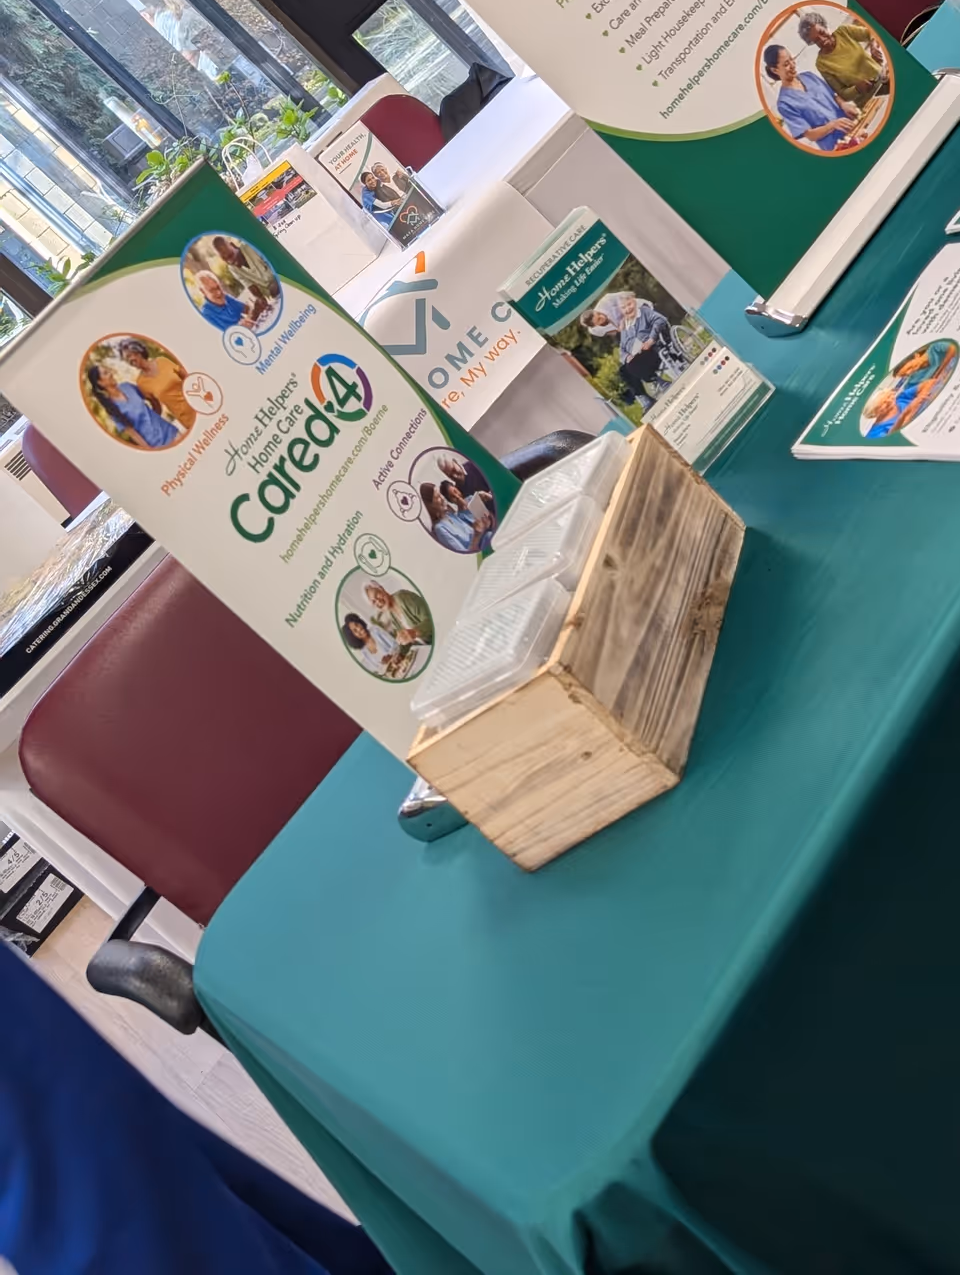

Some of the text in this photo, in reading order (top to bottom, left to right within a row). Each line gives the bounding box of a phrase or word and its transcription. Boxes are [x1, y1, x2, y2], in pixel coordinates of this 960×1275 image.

[609, 9, 631, 30] Care
[624, 22, 649, 48] Meal
[658, 21, 713, 80] Transportation
[711, 3, 728, 23] and
[642, 42, 665, 65] Light
[328, 132, 367, 166] YOUR HEALTH,
[334, 149, 358, 171] AT HOME
[525, 224, 586, 287] RECUPERATIVE CARE
[535, 271, 572, 312] Home
[553, 285, 578, 309] Making
[573, 272, 587, 287] Life
[255, 303, 316, 375] Mental Wellbeing
[427, 326, 489, 389] OME
[460, 362, 488, 387] My
[484, 329, 521, 362] way.
[161, 413, 229, 497] Physical Wellness
[225, 427, 263, 476] Home
[247, 404, 304, 474] Home Care
[372, 407, 428, 491] Active Connections
[280, 403, 389, 564] homehelpershomecare.com/Boerne
[285, 509, 364, 628] Nutrition and Hydration
[25, 566, 113, 654] CATERING.GRANDANDESSEX.COM
[36, 892, 48, 906] 2/5
